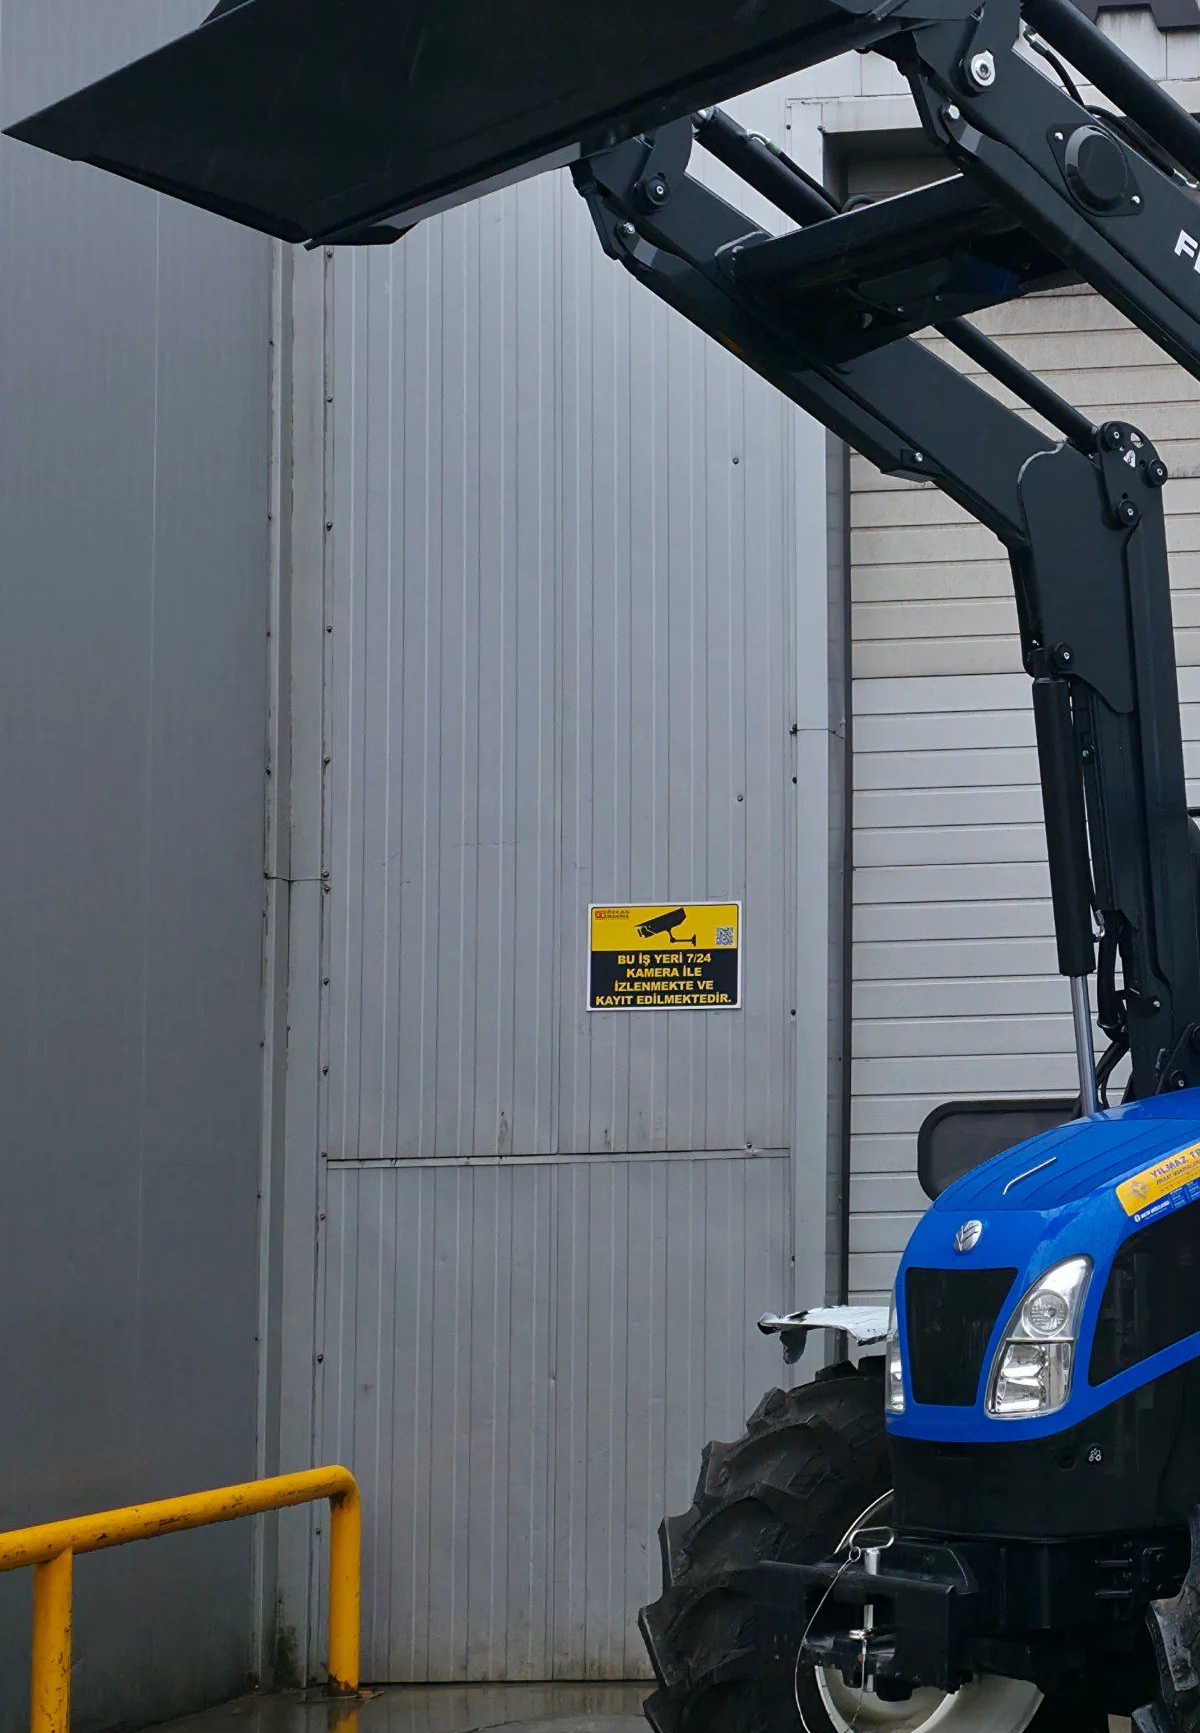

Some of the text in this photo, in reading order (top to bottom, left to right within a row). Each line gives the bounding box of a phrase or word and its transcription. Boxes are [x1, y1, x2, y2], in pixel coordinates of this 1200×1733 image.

[618, 952, 711, 966] BU İŞ YERİ 7/24
[627, 966, 702, 978] KAMERA İLE
[614, 980, 714, 992] İZLENMEKTE VE
[596, 991, 732, 1006] KAYIT EDİLMEKTEDİR.
[1150, 1156, 1189, 1178] YILMAZ
